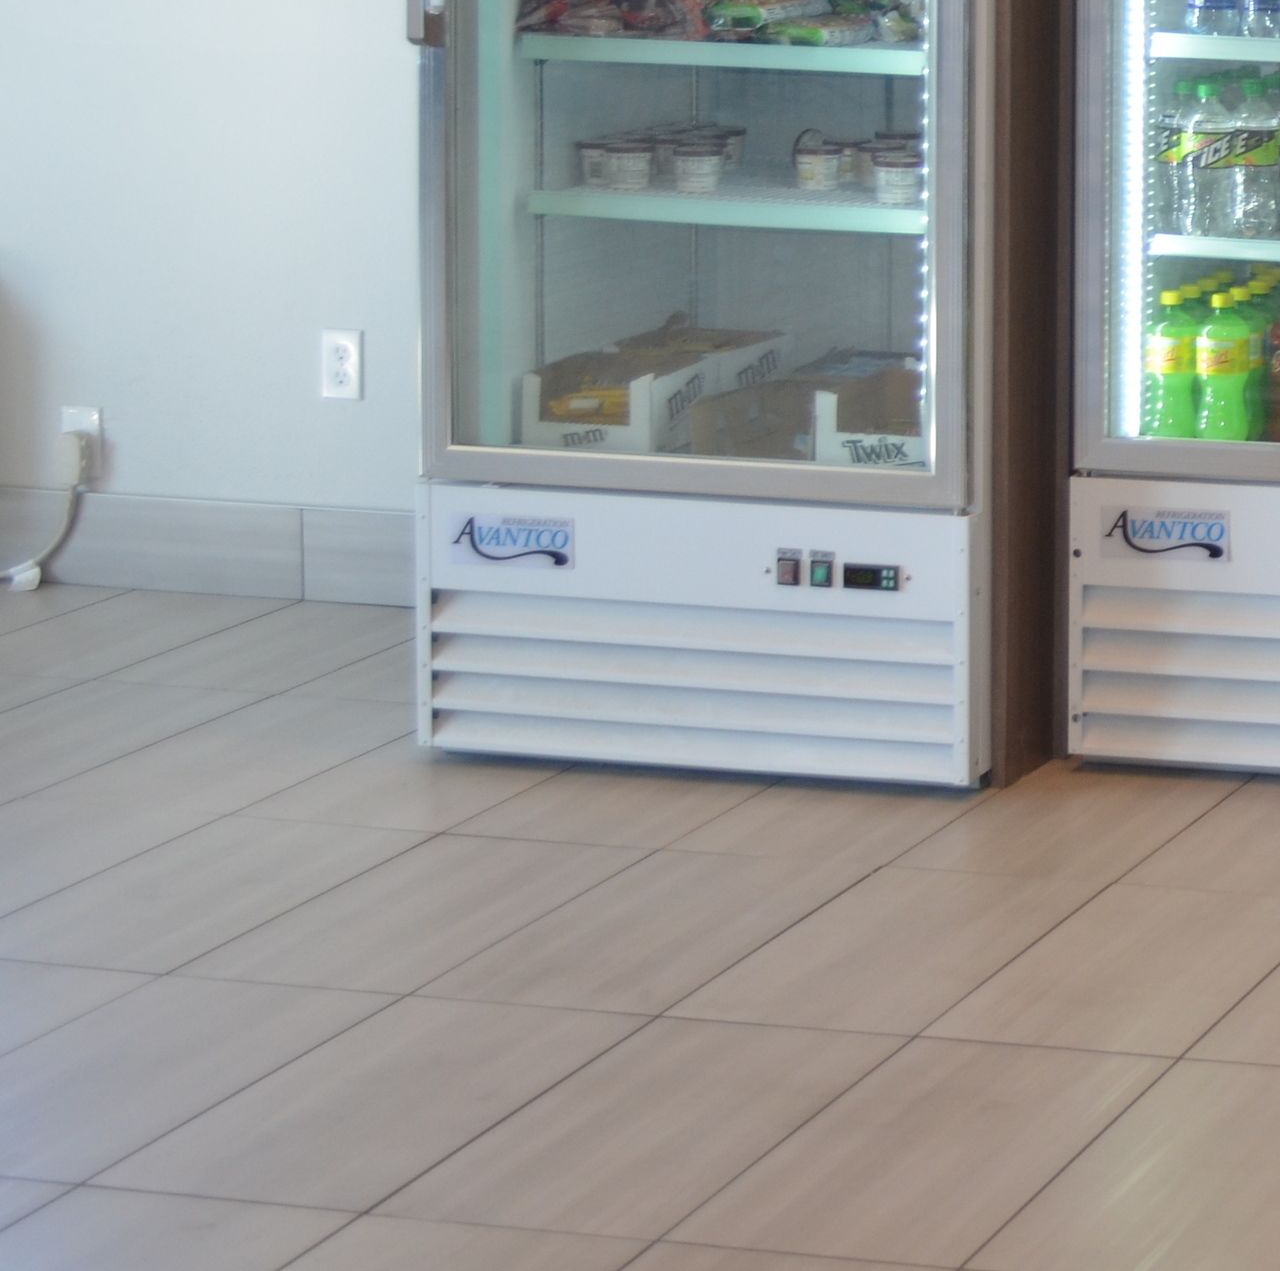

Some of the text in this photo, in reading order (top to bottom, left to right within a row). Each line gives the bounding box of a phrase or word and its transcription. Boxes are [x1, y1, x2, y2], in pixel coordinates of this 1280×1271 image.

[1200, 134, 1233, 168] ICE
[452, 517, 569, 555] AVANTCO
[1104, 510, 1225, 549] AVANTCO
